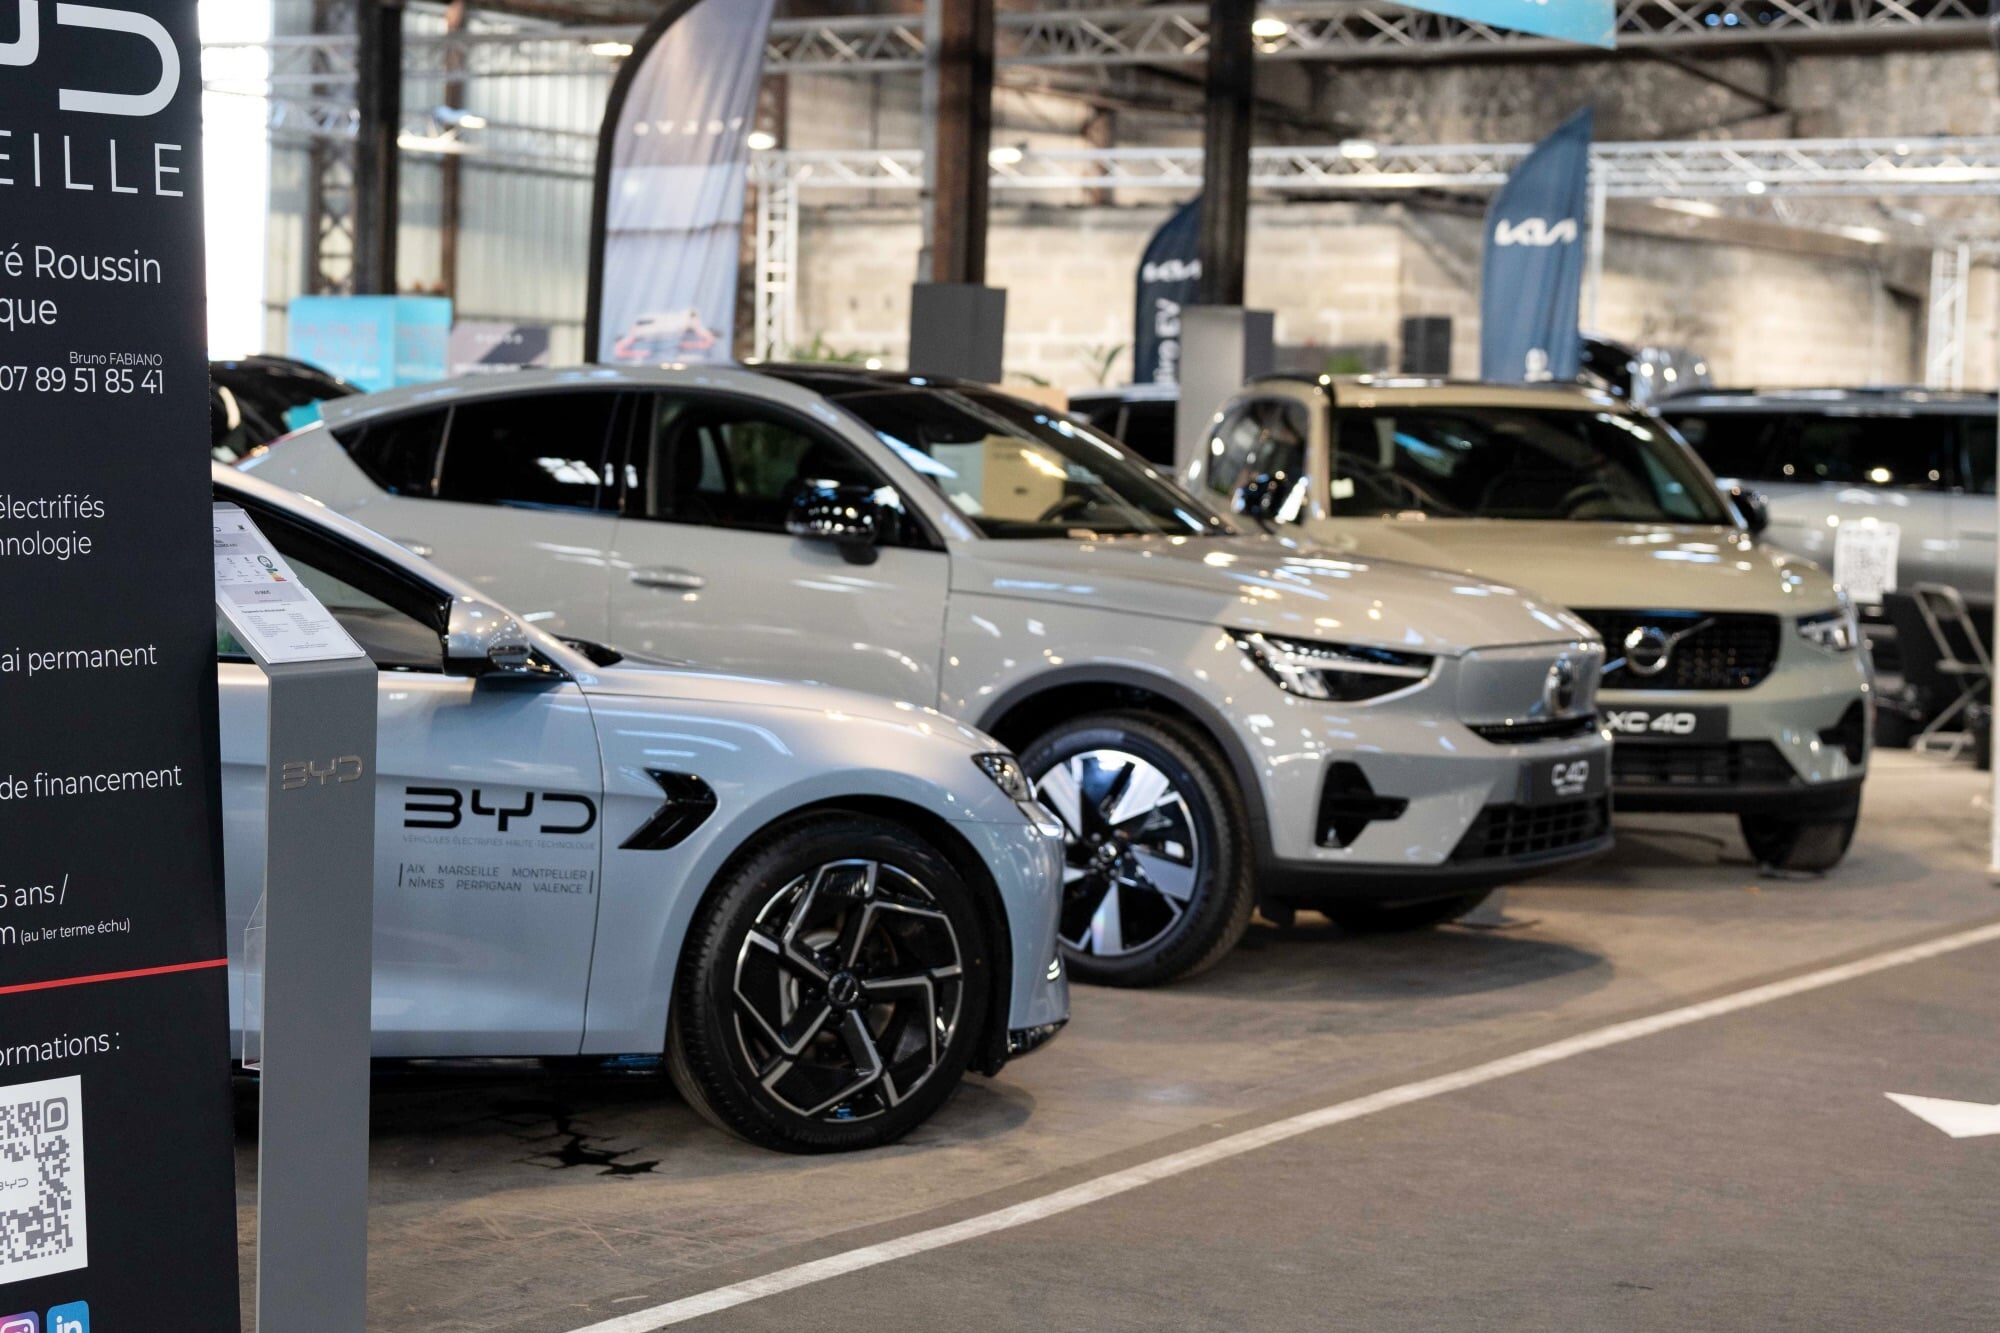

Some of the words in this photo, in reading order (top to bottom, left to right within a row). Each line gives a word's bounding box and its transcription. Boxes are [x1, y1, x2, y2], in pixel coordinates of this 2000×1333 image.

[0, 242, 24, 277] é
[35, 245, 161, 284] Roussin
[0, 297, 58, 332] que
[69, 351, 107, 365] Bruno
[109, 352, 163, 366] FABIANO
[0, 365, 28, 391] 07
[35, 366, 67, 392] 89
[74, 367, 96, 393] 51
[105, 368, 134, 394] 85
[141, 369, 164, 395] 41
[0, 530, 92, 560] nologie
[28, 643, 158, 677] permanent
[0, 774, 28, 800] de
[34, 764, 183, 798] financement
[281, 755, 363, 790] BYD
[403, 786, 598, 834] BYD
[406, 863, 425, 874] AIX
[438, 865, 499, 877] MARSEILLE
[512, 868, 587, 880] MONTPELLIER
[408, 877, 445, 889] NÎMES
[456, 879, 522, 892] PERPIGNAN
[533, 883, 583, 894] VALENCE
[14, 884, 55, 907] ans
[20, 930, 39, 946] (au
[42, 927, 57, 940] 1er
[59, 923, 96, 939] terme
[97, 917, 131, 934] échu)
[0, 1032, 110, 1067] rmations
